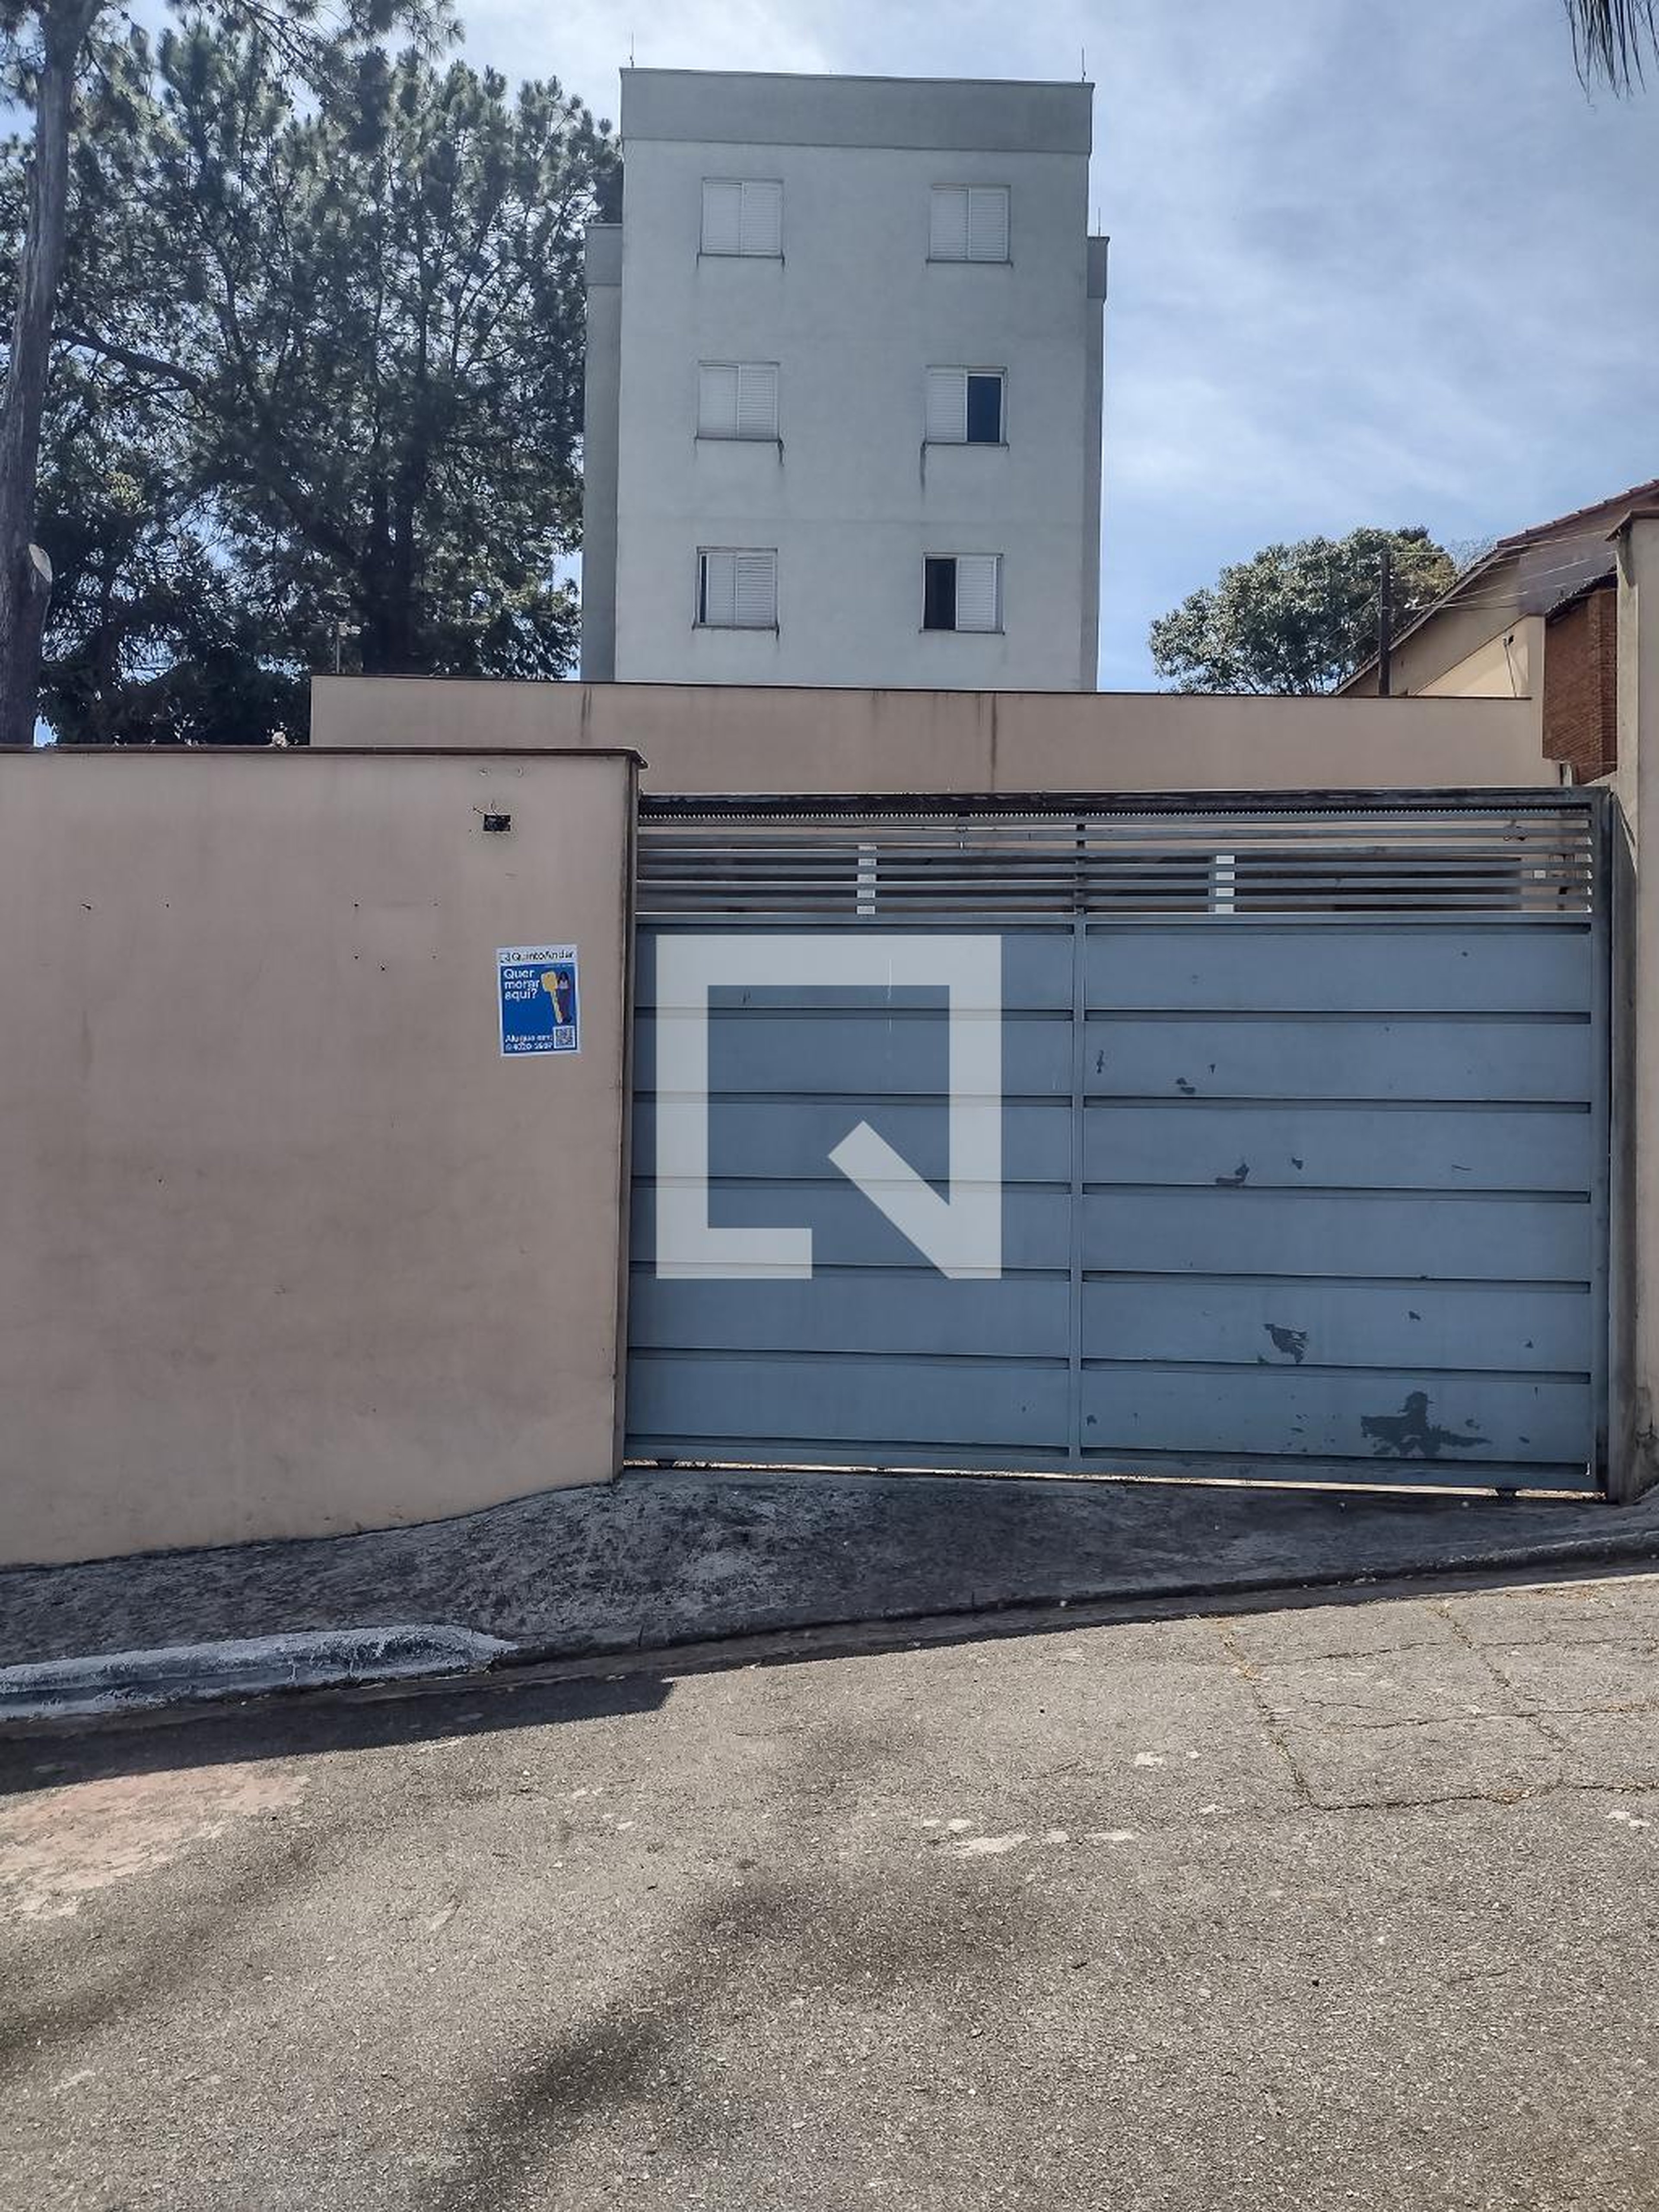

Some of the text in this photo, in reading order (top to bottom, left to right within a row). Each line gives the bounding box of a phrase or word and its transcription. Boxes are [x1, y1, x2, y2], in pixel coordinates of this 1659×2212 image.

[504, 969, 534, 980] Quer
[505, 980, 540, 989] morar
[505, 989, 537, 1002] aqui?
